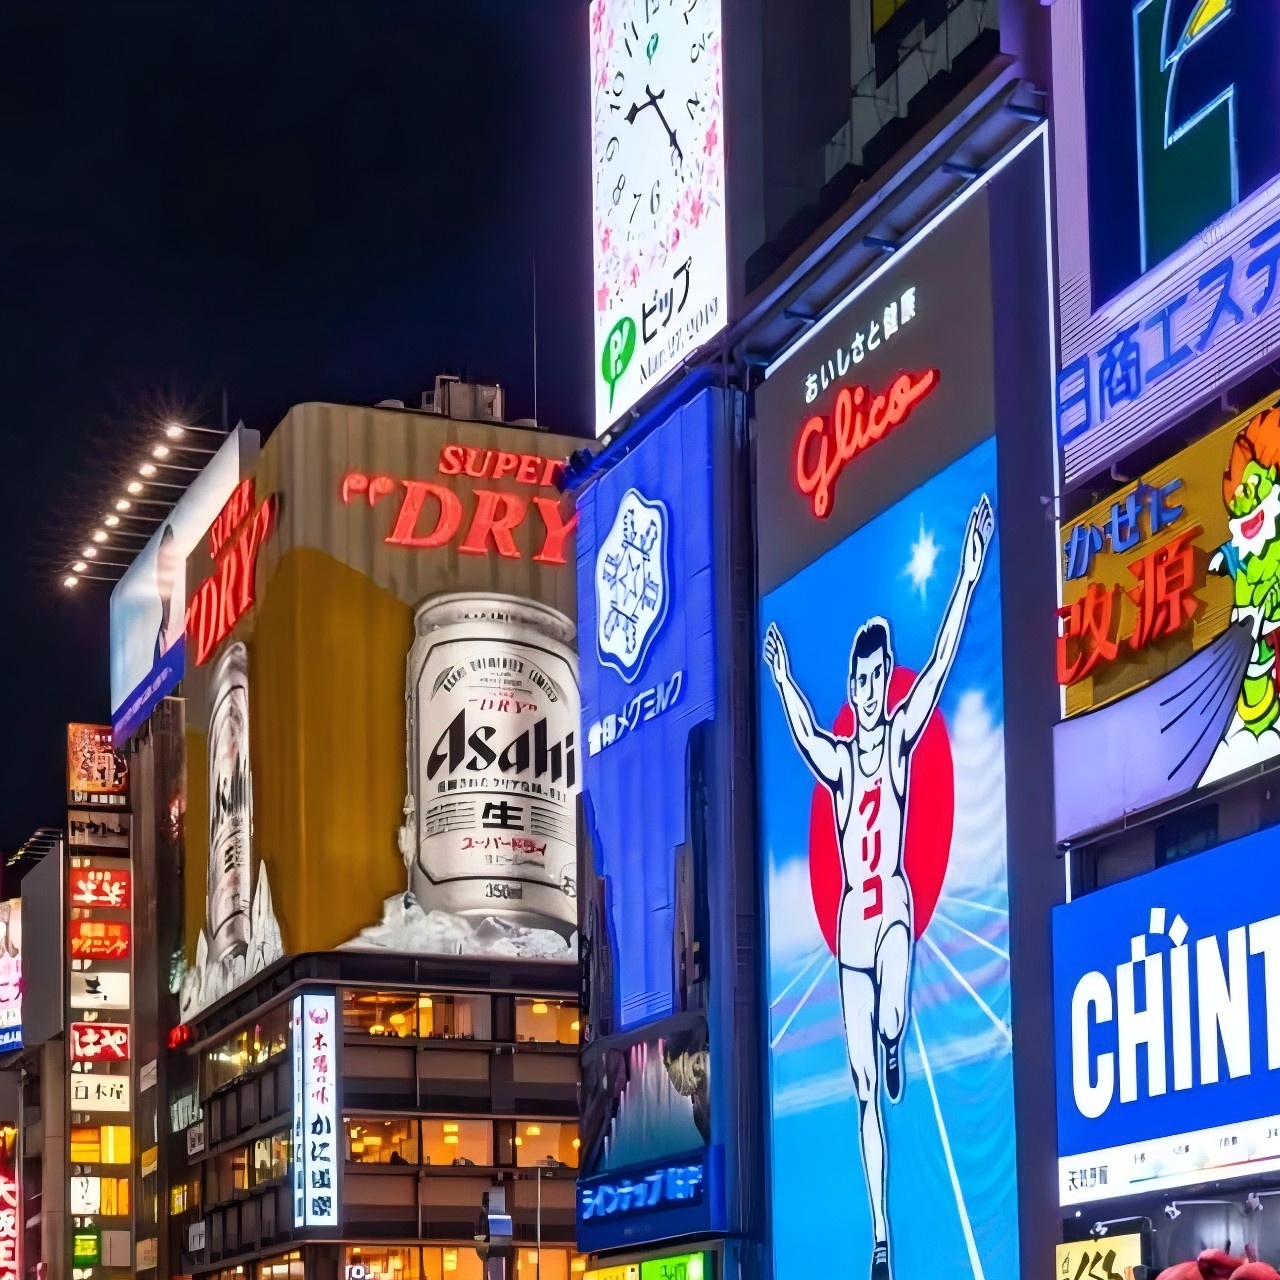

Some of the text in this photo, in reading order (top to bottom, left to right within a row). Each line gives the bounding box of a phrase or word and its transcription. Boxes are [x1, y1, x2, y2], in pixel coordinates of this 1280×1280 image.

[642, 255, 692, 345] ビップ
[1056, 524, 1206, 688] 改源
[426, 708, 576, 789] Asahi
[482, 801, 524, 831] 生
[859, 777, 883, 921] グリコ
